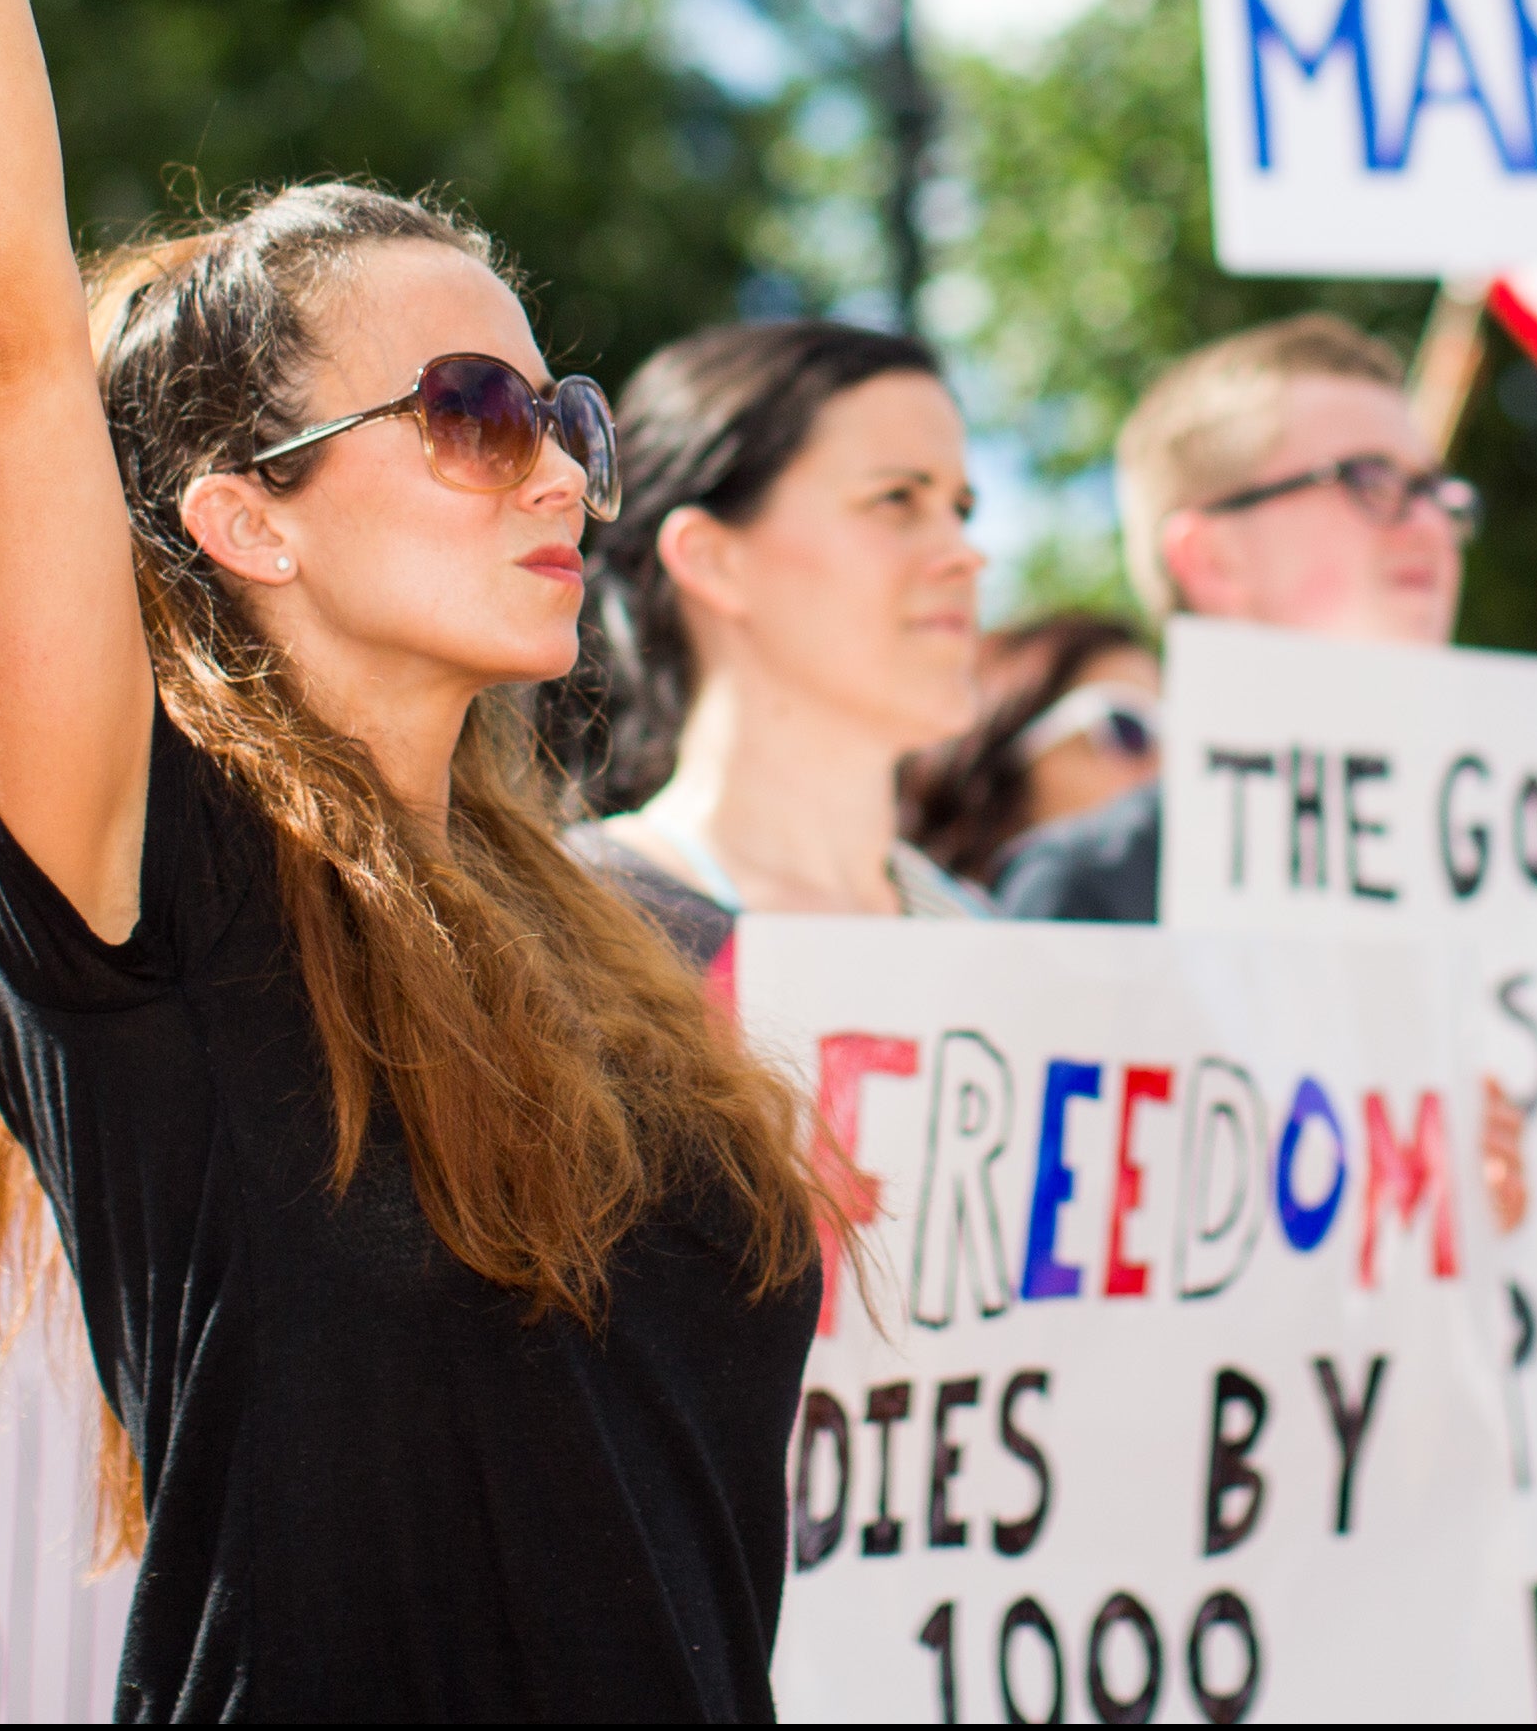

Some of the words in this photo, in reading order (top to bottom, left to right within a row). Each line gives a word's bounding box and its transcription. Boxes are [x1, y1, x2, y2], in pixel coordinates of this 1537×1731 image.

[1205, 746, 1401, 904] THE
[809, 1026, 1463, 1340] FREEDOM
[793, 1368, 1054, 1576] DIES
[1200, 1352, 1393, 1560] BY
[915, 1588, 1264, 1724] 1000
